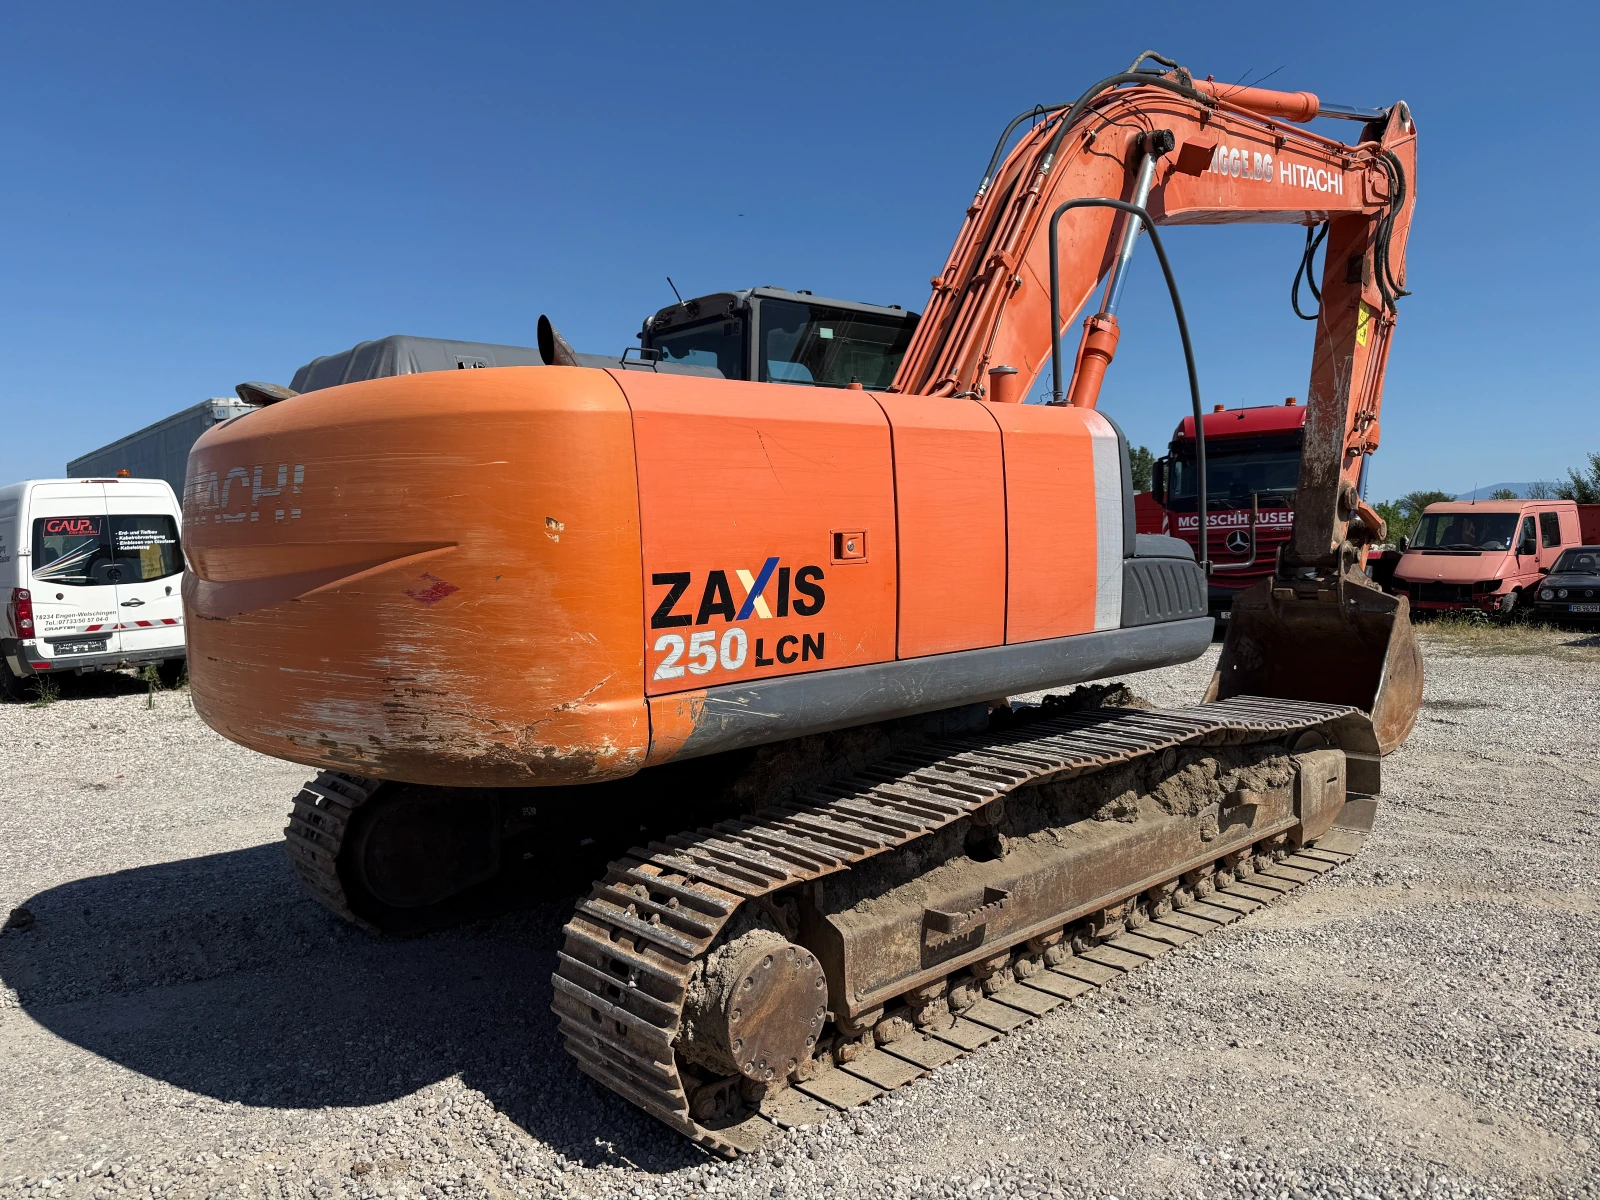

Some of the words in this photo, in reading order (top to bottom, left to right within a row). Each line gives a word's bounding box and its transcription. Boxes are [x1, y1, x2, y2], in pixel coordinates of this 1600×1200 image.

[1279, 160, 1343, 195] HITACHI
[651, 556, 826, 629] ZAXIS
[653, 627, 748, 682] 250
[755, 632, 825, 668] LCN
